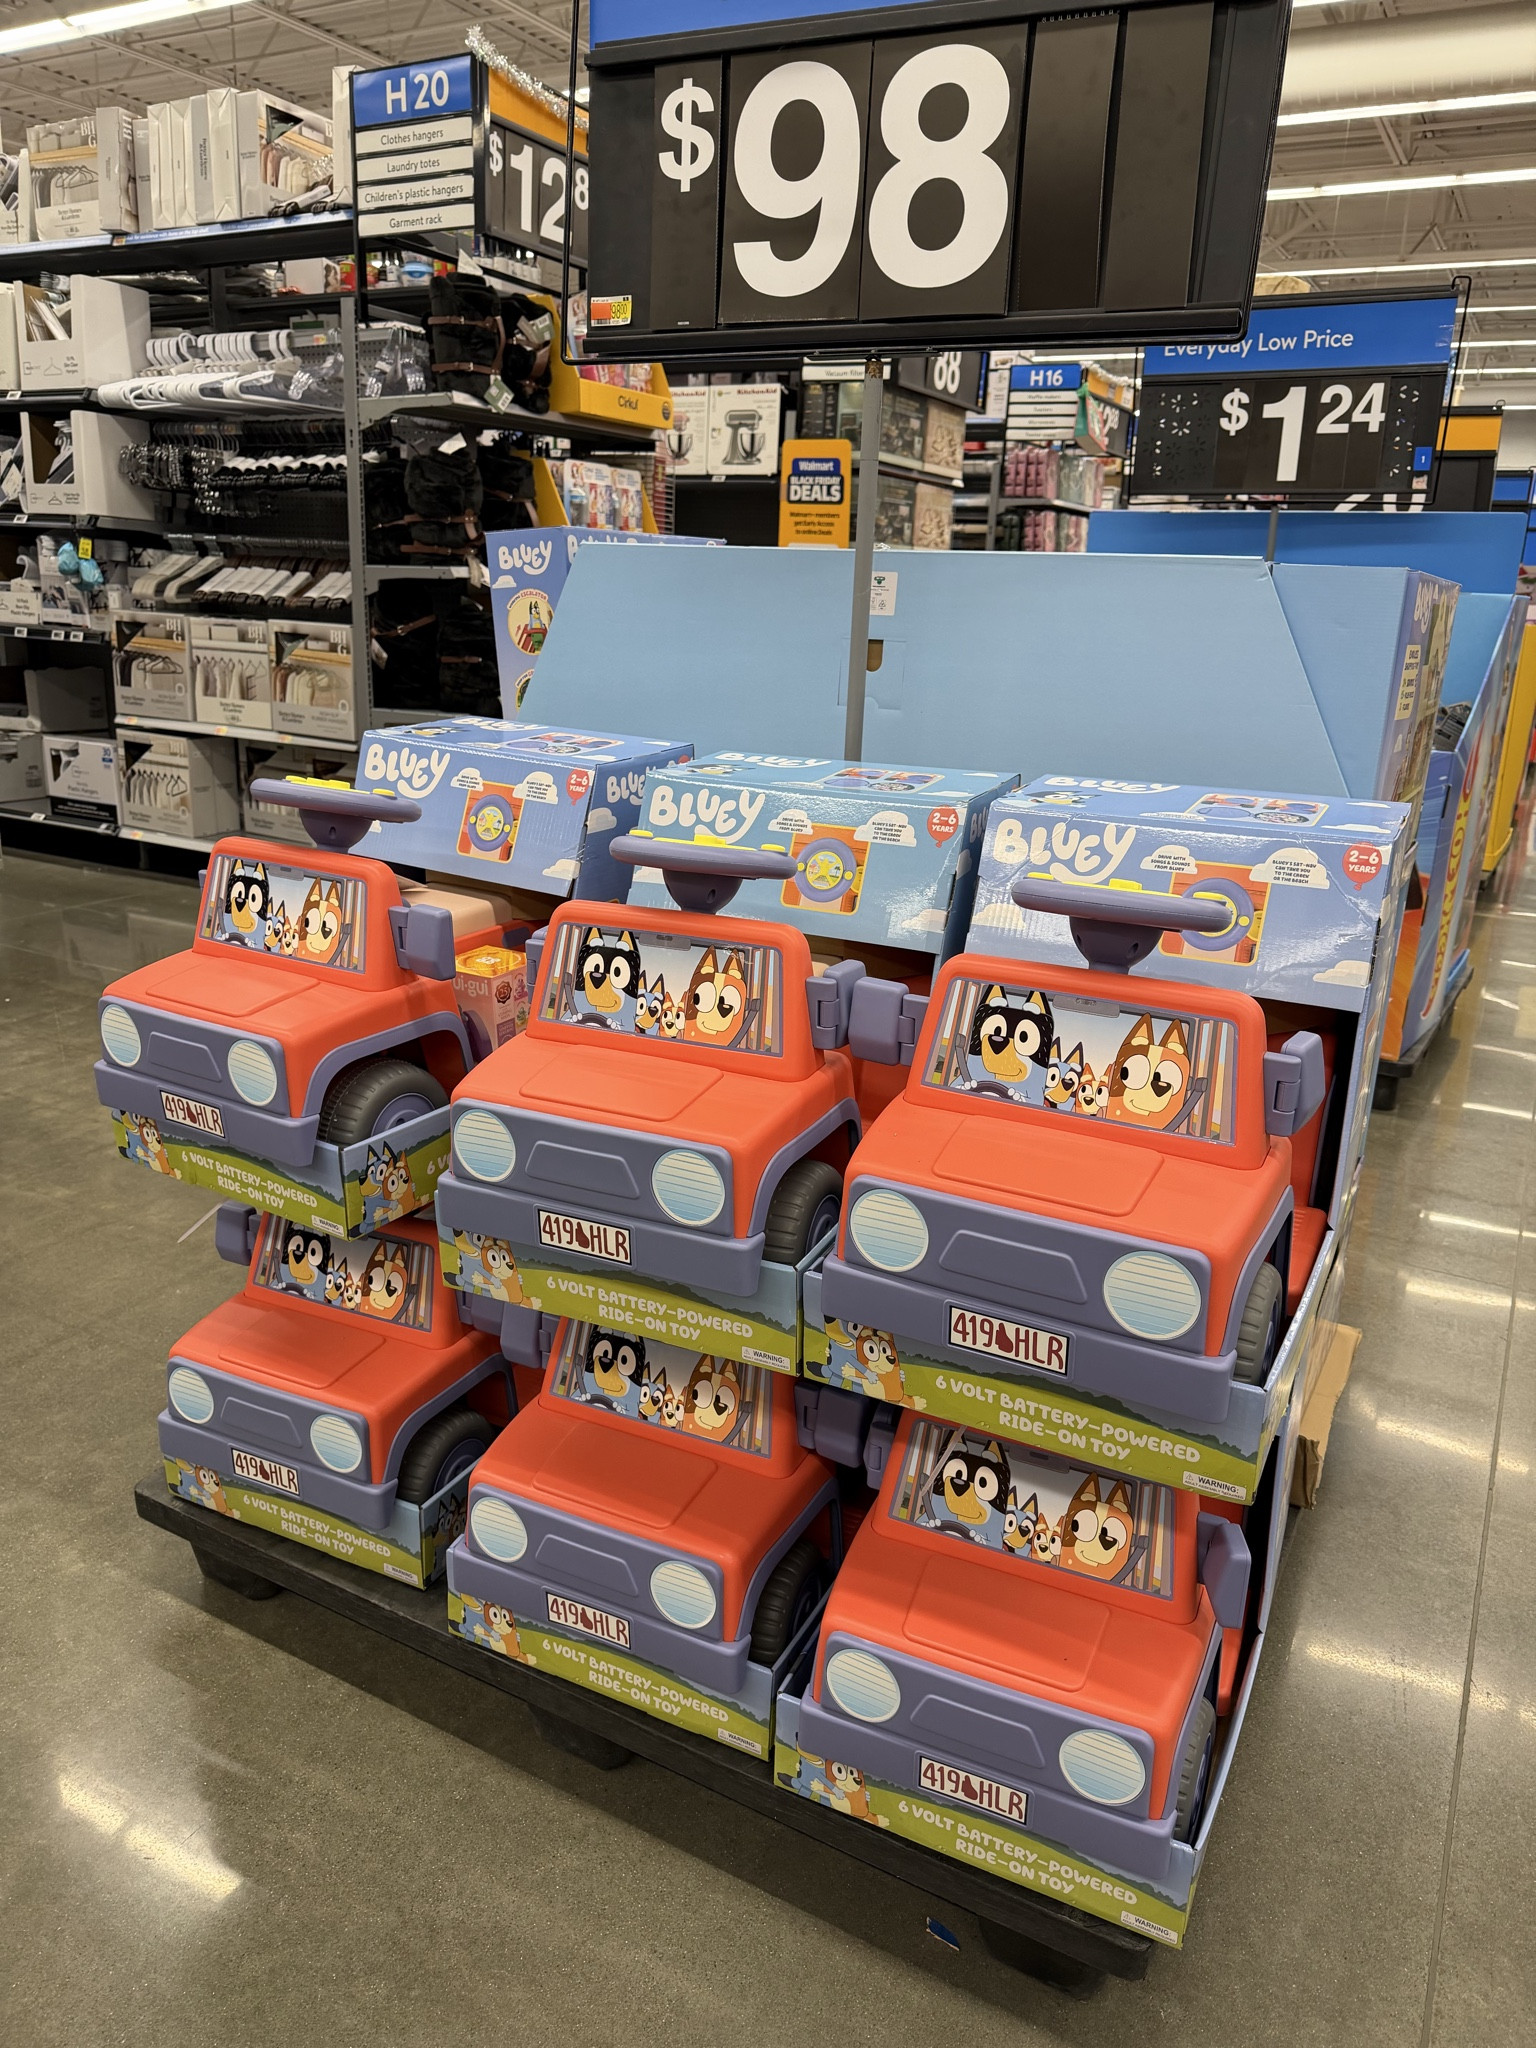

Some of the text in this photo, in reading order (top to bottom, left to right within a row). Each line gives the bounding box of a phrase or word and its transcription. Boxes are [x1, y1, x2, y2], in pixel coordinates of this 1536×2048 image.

[381, 129, 444, 146] Clothes hangers
[387, 159, 441, 173] Laundry totes
[364, 184, 464, 204] Children's plastic hangers
[389, 213, 443, 229] Garment rack
[1164, 328, 1355, 360] Everyday Low Price
[1029, 369, 1064, 387] H16
[789, 476, 841, 485] BLACK FRIDAY
[798, 461, 835, 472] Walmart
[789, 485, 841, 502] DEALS
[569, 785, 586, 793] YEARS
[606, 766, 656, 806] BLUE
[931, 825, 954, 833] YEARS
[1272, 859, 1317, 869] BLUEY'S SAT-NAV
[1348, 864, 1377, 874] YEARS
[196, 1105, 223, 1136] HLR
[182, 1151, 318, 1208] 6 VOLT BATTERY-POWERED
[427, 1161, 436, 1175] 6
[218, 1175, 285, 1209] RIDE-ON TOY
[590, 1225, 629, 1261] HLR
[547, 1275, 753, 1338] 6 VOLT BATTERY-POWERED
[598, 1304, 701, 1341] RIDE-ON TOY
[752, 1350, 785, 1364] WARNING:
[1014, 1328, 1064, 1371] HLR
[935, 1375, 1201, 1463] 6 VOLT BATTERY-POWERED
[999, 1411, 1131, 1461] RIDE-ON TOY
[269, 1463, 298, 1492] HLR
[1197, 1475, 1239, 1494] WARNING:
[243, 1494, 391, 1558] 6 VOLT BATTERY-POWERED
[281, 1520, 355, 1556] RIDE-ON TOY
[594, 1612, 629, 1646] HLR
[542, 1639, 729, 1722] 6 VOLT BATTERY-POWERED
[589, 1670, 681, 1716] RIDE-ON TOY
[979, 1778, 1026, 1820] HLR
[897, 1800, 1138, 1905] 6 VOLT BATTERY-POWERED
[955, 1838, 1076, 1895] RIDE-ON TOY
[1134, 1916, 1172, 1937] WARNING:
